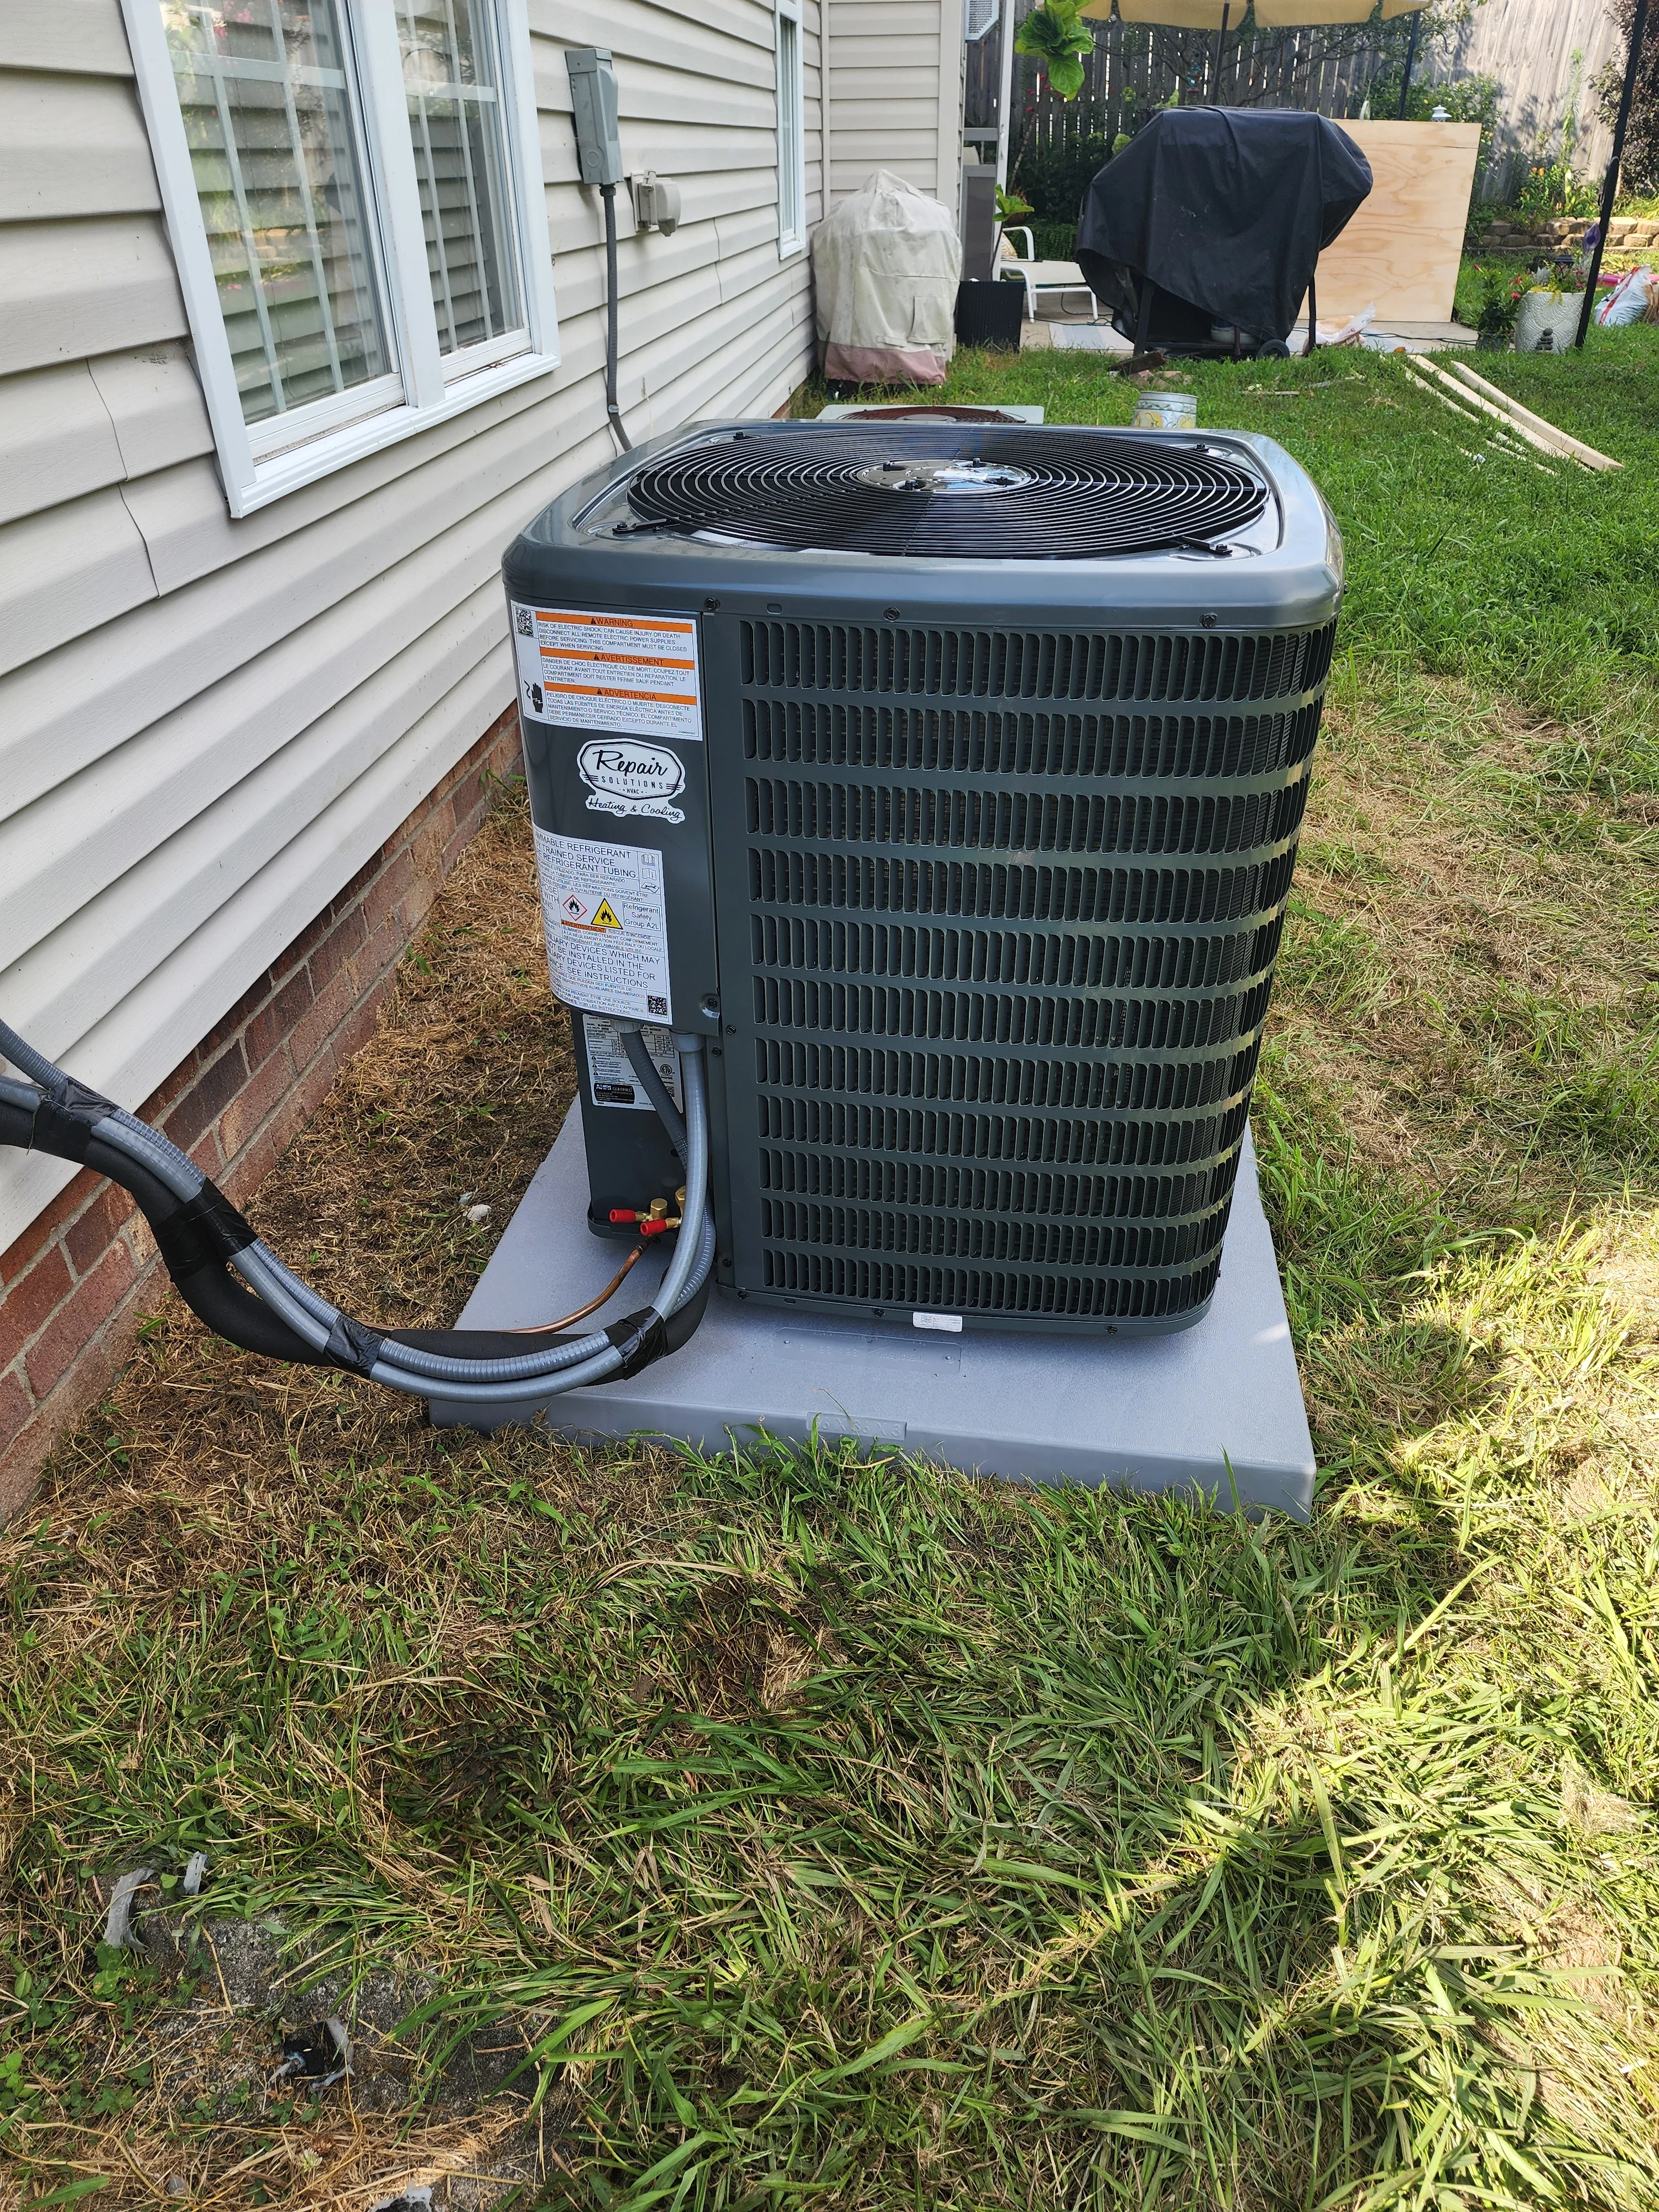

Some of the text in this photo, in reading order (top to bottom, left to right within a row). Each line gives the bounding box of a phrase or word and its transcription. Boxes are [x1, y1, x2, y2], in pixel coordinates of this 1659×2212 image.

[596, 618, 633, 627] WARNING
[601, 654, 664, 666] AVERTISSEMENT
[544, 669, 582, 677] COMPARTIMENT
[604, 690, 656, 701] ADVERTENCIA
[549, 703, 587, 712] MANTENIMIENTO
[648, 714, 691, 723] COMPARTIMENTO
[562, 711, 596, 719] PERMANECER
[592, 749, 667, 776] Repair
[601, 776, 663, 789] SOLUTIONS
[588, 797, 627, 814] Heating
[641, 804, 682, 821] Cooling
[542, 844, 574, 860] TRAINED
[576, 854, 615, 867] SERVICE
[567, 843, 631, 859] REFRIGERANT
[543, 853, 599, 872] REFRIGERANT
[602, 867, 638, 878] TUBING.
[624, 902, 659, 914] Refrigerant
[625, 919, 645, 928] Group
[632, 911, 651, 921] Safety
[559, 946, 566, 956] BE
[568, 950, 614, 964] INSTALLED
[627, 961, 644, 970] THE
[571, 942, 660, 964] DEVICES WHICH MAY
[567, 958, 656, 980] DEVICES LISTED FOR
[567, 967, 582, 977] SEE
[585, 971, 650, 989] INSTRUCTIONS.
[891, 1423, 901, 1438] 3
